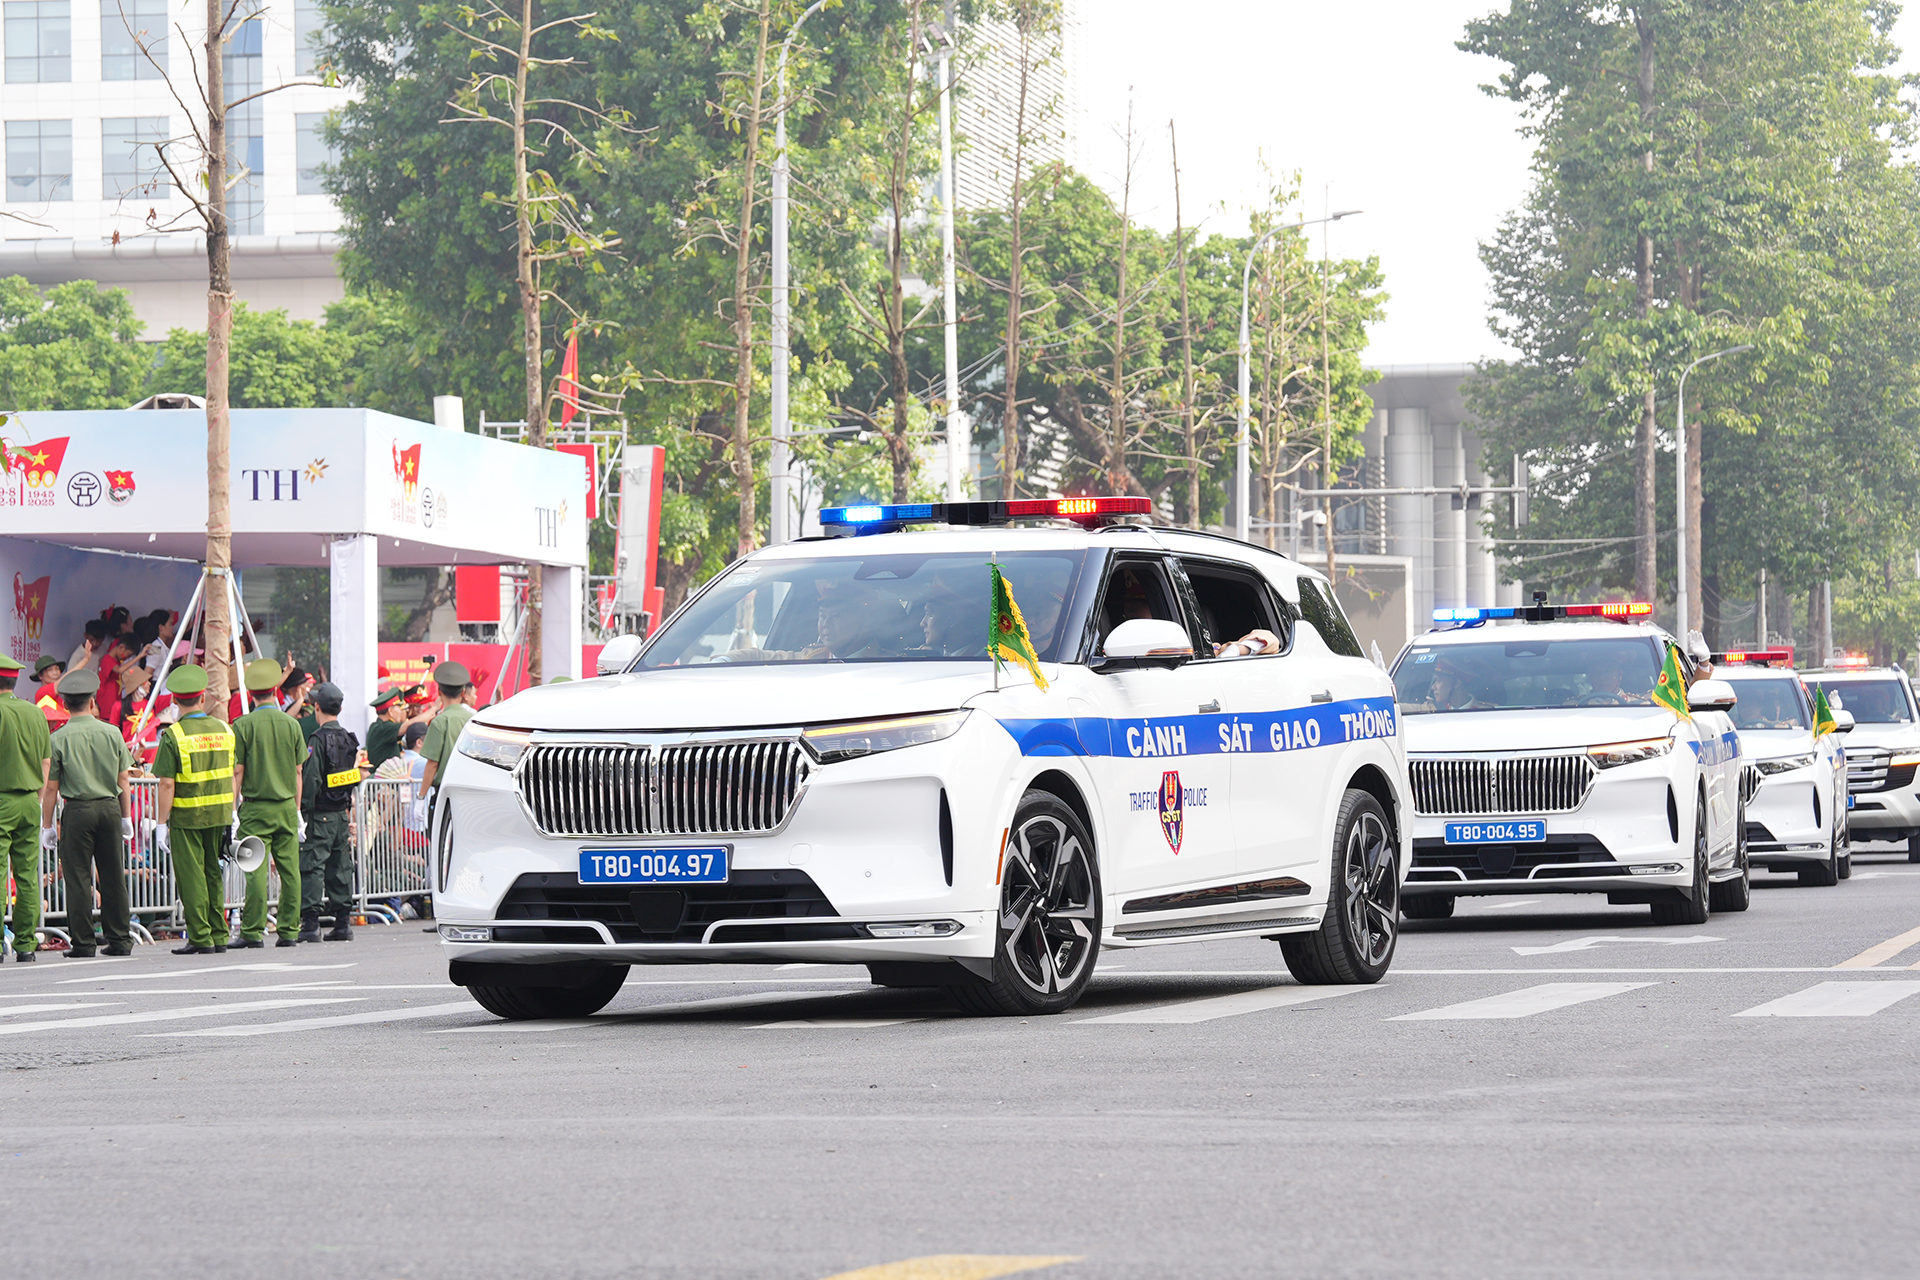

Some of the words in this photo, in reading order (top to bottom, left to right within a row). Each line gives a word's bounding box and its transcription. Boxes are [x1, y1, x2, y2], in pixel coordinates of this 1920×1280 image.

[27, 470, 56, 488] 80
[242, 469, 301, 501] TH
[28, 490, 55, 498] 1945
[28, 498, 55, 506] 2025
[535, 506, 557, 548] TH
[28, 616, 42, 640] 80
[27, 642, 41, 652] 1945
[194, 734, 213, 742] CÔNG
[1126, 719, 1187, 757] CẢNH
[1218, 716, 1253, 752] SÁT
[1270, 718, 1321, 751] GIAO
[1340, 704, 1395, 741] THÔNG
[1129, 791, 1158, 811] TRAFFIC
[1183, 787, 1208, 807] POLICE
[1453, 824, 1537, 840] T80-004.95
[591, 854, 714, 877] T80-004.97
